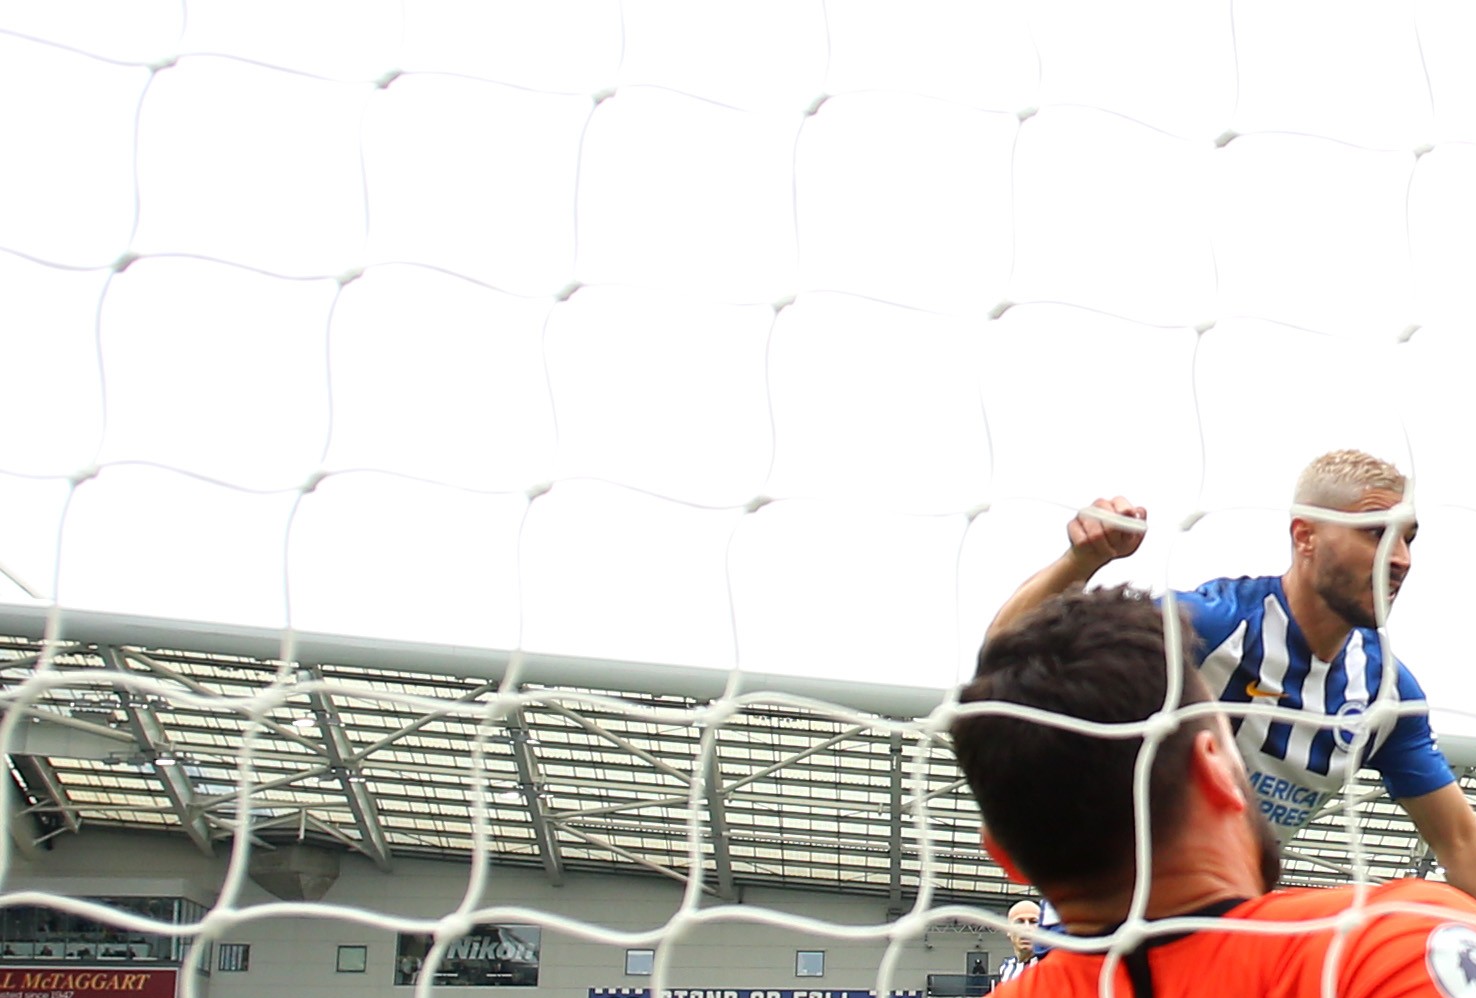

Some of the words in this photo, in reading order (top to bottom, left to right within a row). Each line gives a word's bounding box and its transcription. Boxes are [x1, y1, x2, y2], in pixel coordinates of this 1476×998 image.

[1249, 770, 1329, 808] MERICA
[1259, 800, 1310, 828] PRES
[21, 972, 151, 991] McTAGGART
